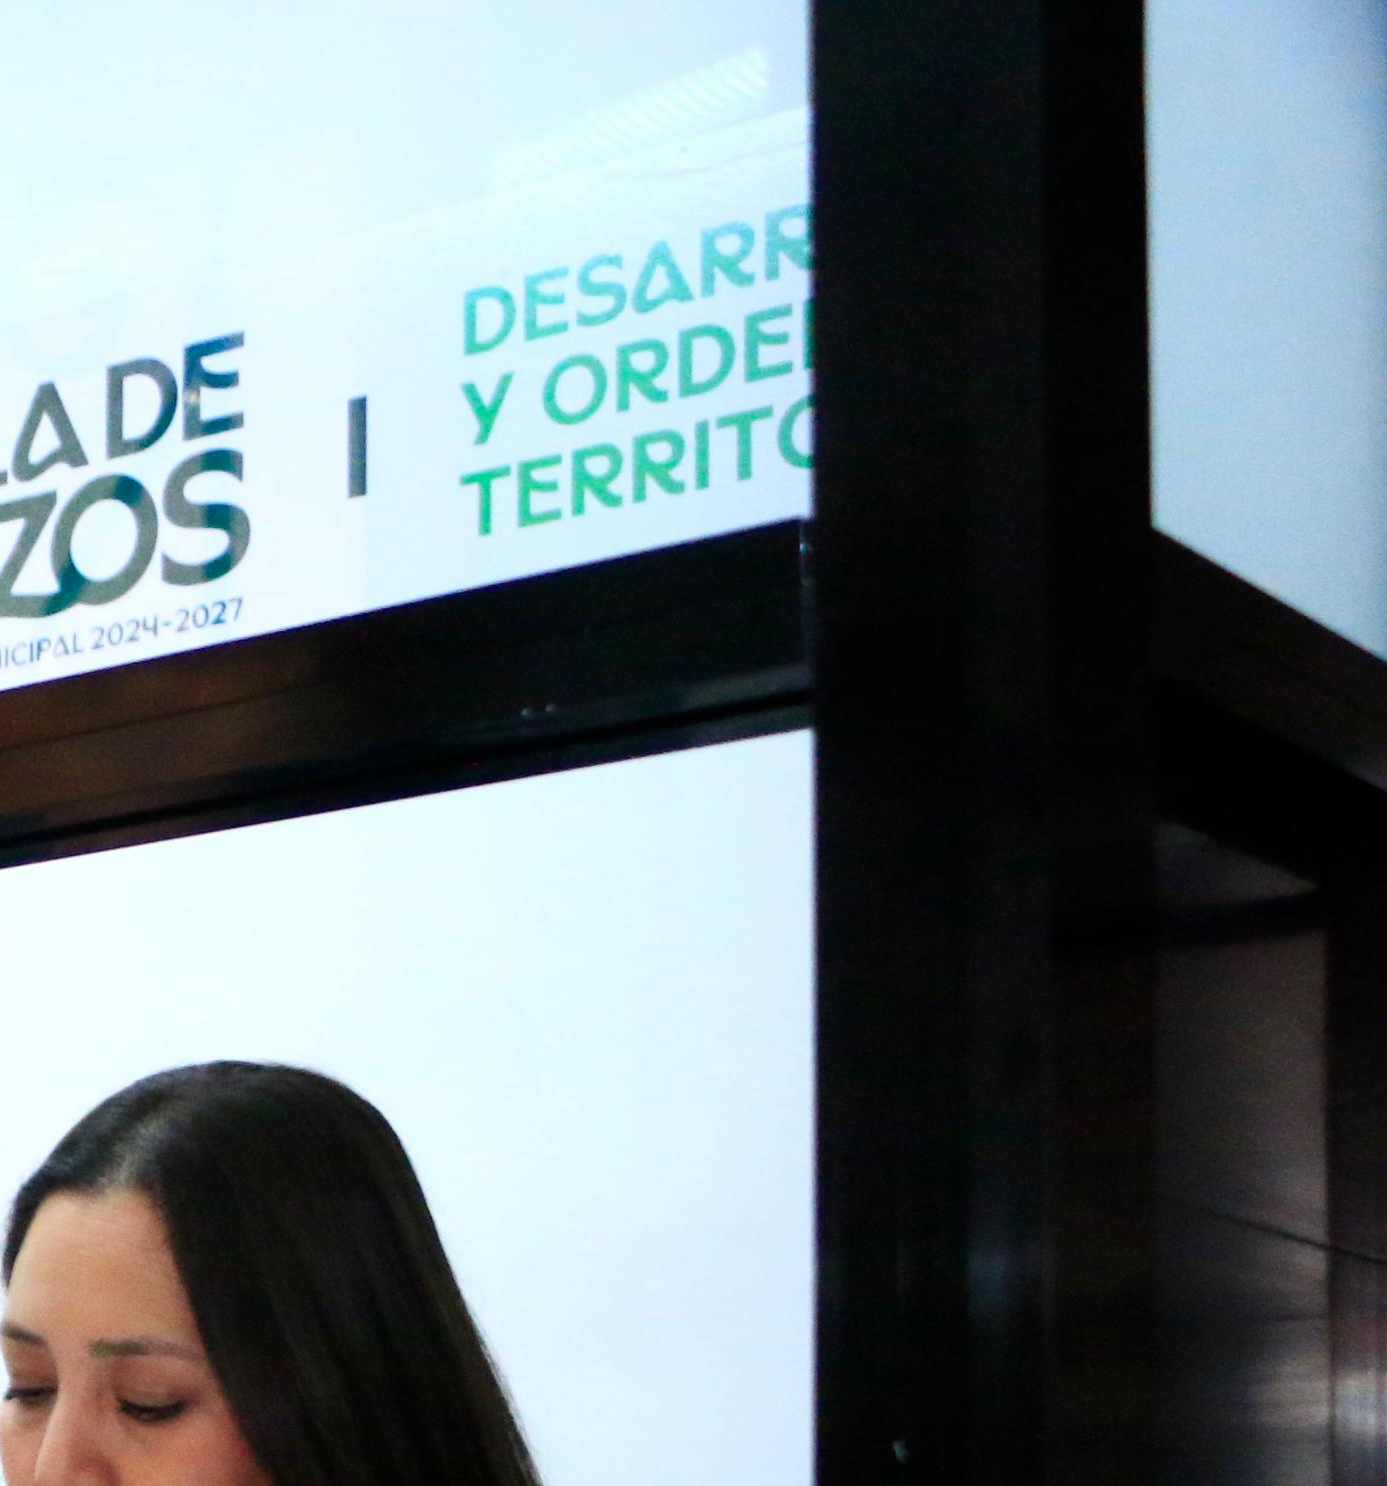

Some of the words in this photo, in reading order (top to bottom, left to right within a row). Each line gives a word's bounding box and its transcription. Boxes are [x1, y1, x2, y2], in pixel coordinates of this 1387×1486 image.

[106, 331, 245, 460] DE
[461, 371, 514, 446] Y
[543, 300, 814, 425] ORDE
[91, 597, 244, 650] 2024-2027
